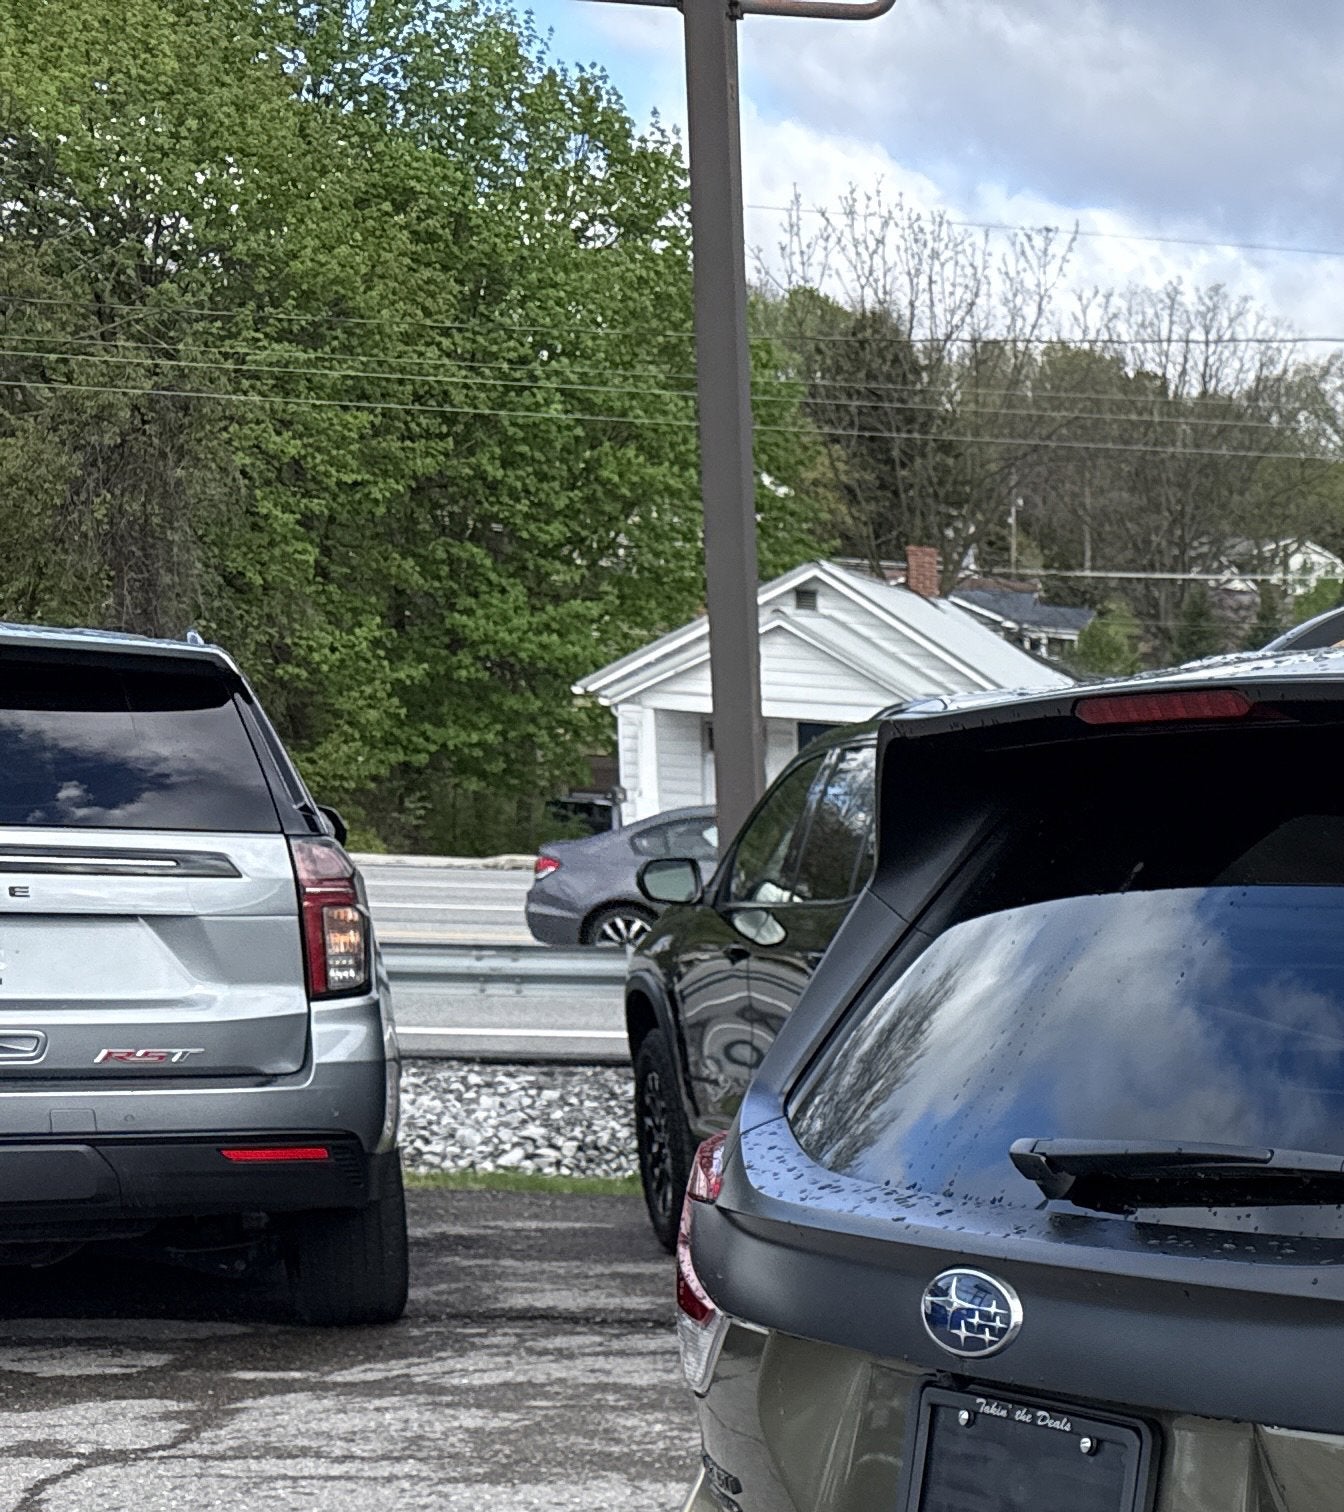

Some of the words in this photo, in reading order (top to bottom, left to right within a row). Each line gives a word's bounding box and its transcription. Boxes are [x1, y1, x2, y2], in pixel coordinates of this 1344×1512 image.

[94, 1048, 205, 1064] RST
[1014, 1407, 1033, 1423] the
[1036, 1410, 1072, 1432] Deals
